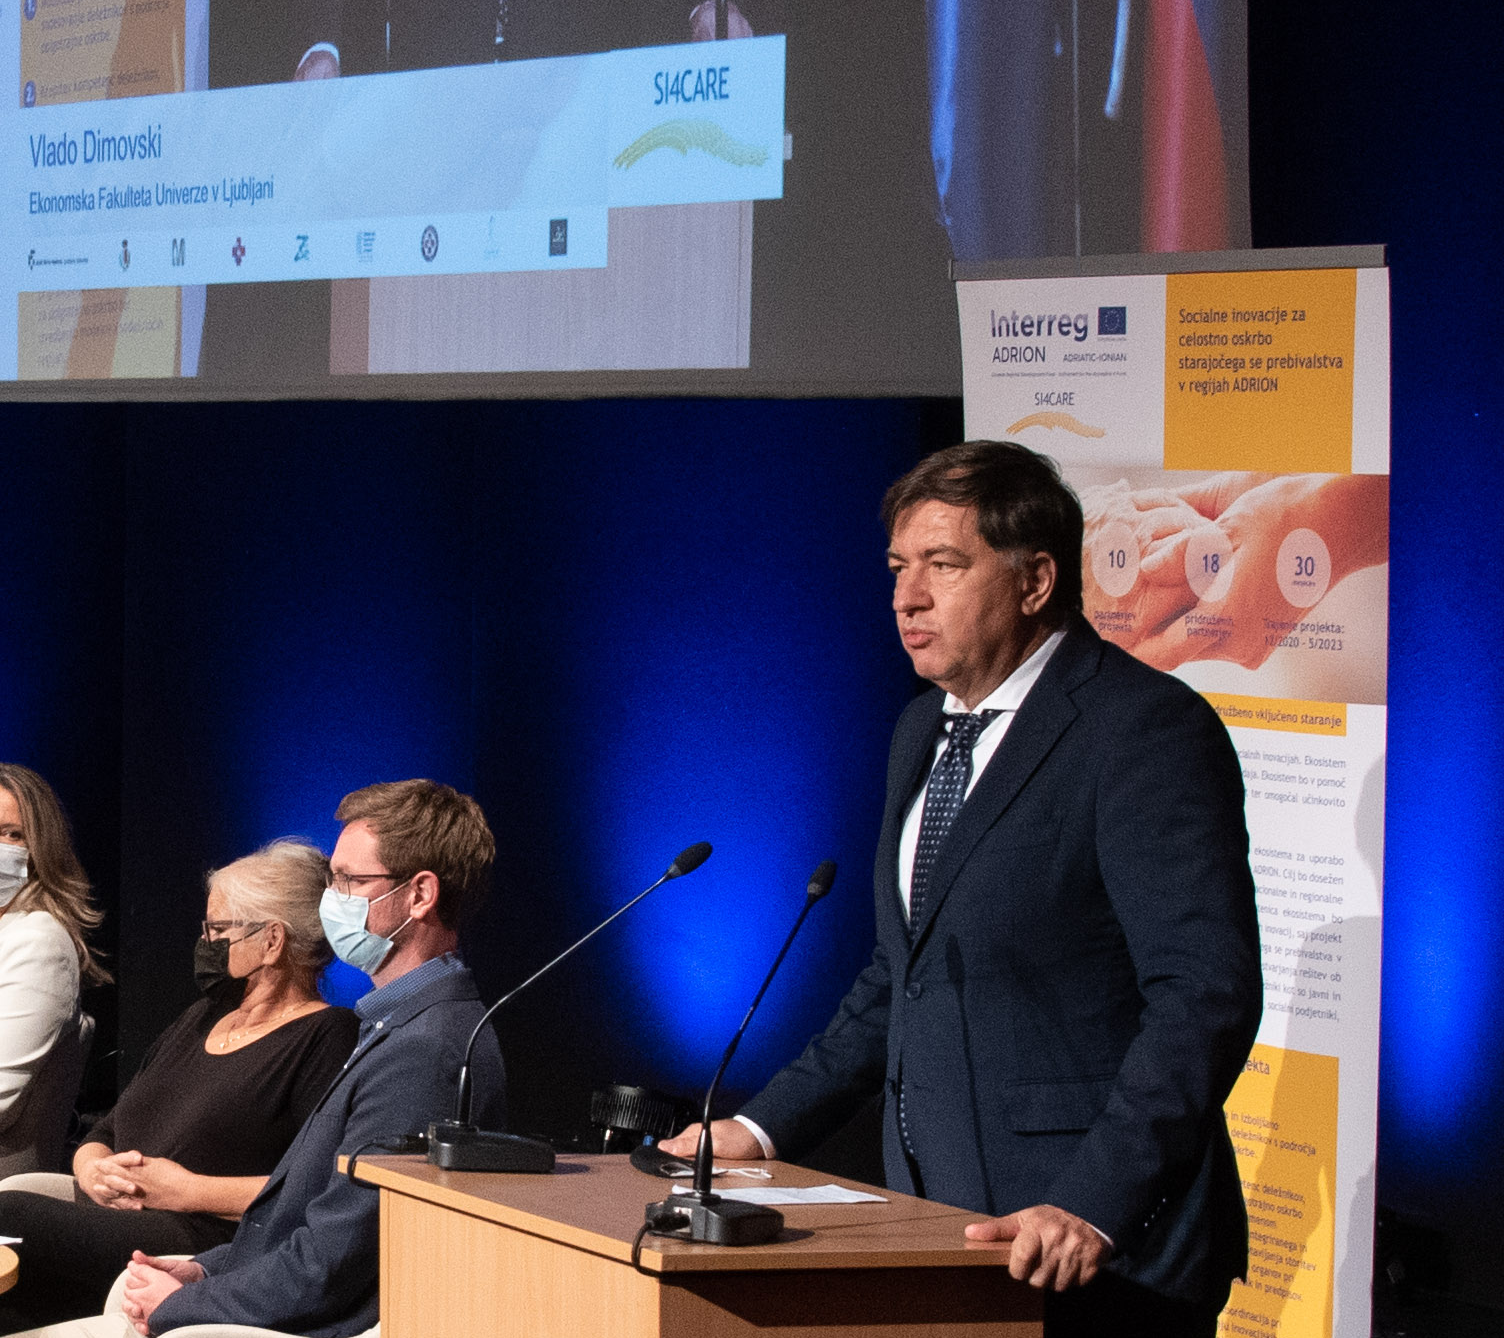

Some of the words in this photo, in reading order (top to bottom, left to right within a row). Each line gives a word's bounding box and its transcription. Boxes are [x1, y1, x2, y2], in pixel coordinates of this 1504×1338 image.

[653, 66, 730, 105] SI4CARE
[30, 132, 77, 168] Vlado
[83, 124, 162, 164] Dimovski
[29, 184, 95, 215] Ekonomska
[98, 183, 152, 210] Fakulteta
[156, 181, 208, 207] Univerze
[211, 188, 219, 201] v
[222, 175, 274, 208] Ljubljani
[1178, 308, 1228, 323] Socialne
[1232, 306, 1288, 325] inovacije
[1291, 310, 1306, 322] za
[991, 309, 1089, 342] Interreg
[1178, 332, 1228, 347] celostno
[1231, 330, 1272, 346] oskrbo
[992, 346, 1046, 363] ADRION
[1178, 353, 1246, 373] starajočega
[1249, 359, 1262, 370] se
[1266, 353, 1343, 372] prebivalstva
[1178, 381, 1186, 392] v
[1189, 376, 1230, 396] regijah
[1232, 376, 1278, 393] ADRION
[1034, 392, 1075, 406] SI4CARE
[1108, 549, 1126, 569] 10
[1202, 553, 1220, 573] 18
[1295, 555, 1315, 577] 30
[1300, 622, 1345, 635] projekta:
[1308, 638, 1343, 651] 5/2023
[1256, 708, 1298, 724] vključeno
[1300, 713, 1342, 729] staranje
[1304, 755, 1346, 769] Ekosistem
[1317, 777, 1346, 788] pomoč
[1309, 855, 1344, 866] uporabo
[1309, 872, 1344, 885] dosežen
[1299, 892, 1344, 904] regionalne
[1331, 913, 1344, 924] bo
[1310, 932, 1343, 944] projekt
[1299, 967, 1328, 980] rešitev
[1330, 972, 1342, 983] ob
[1308, 988, 1330, 1000] javni
[1332, 991, 1342, 1001] in
